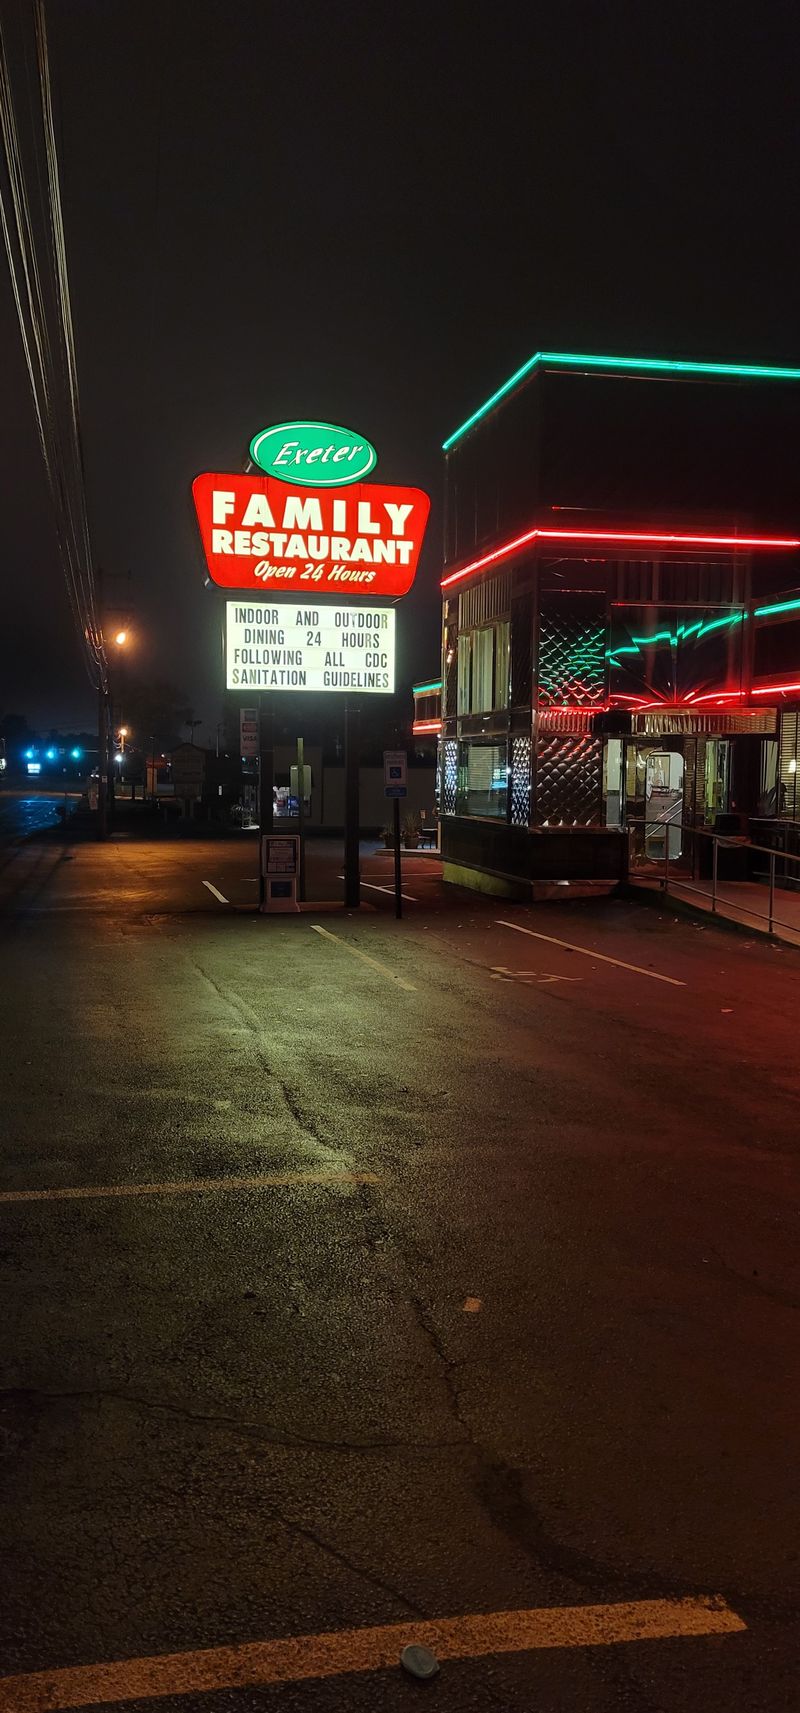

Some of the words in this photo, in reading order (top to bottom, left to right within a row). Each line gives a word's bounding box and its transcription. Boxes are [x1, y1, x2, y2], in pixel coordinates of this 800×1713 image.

[272, 441, 364, 467] Exeter
[212, 490, 414, 536] FAMILY
[212, 529, 414, 564] RESTAURANT
[254, 560, 297, 581] Open
[299, 563, 324, 582] 24
[327, 564, 376, 583] Hours
[234, 607, 279, 625] INDOOR
[295, 610, 319, 626] AND
[334, 612, 388, 629] OUTDOOR
[244, 629, 285, 646] DINING
[306, 630, 322, 646] 24
[341, 632, 380, 648] HOURS
[234, 648, 302, 666] FOLLOWING
[325, 651, 345, 667] ALL
[365, 652, 388, 668] CDC
[232, 669, 306, 686] SANITATION
[323, 671, 389, 688] GUIDELINES
